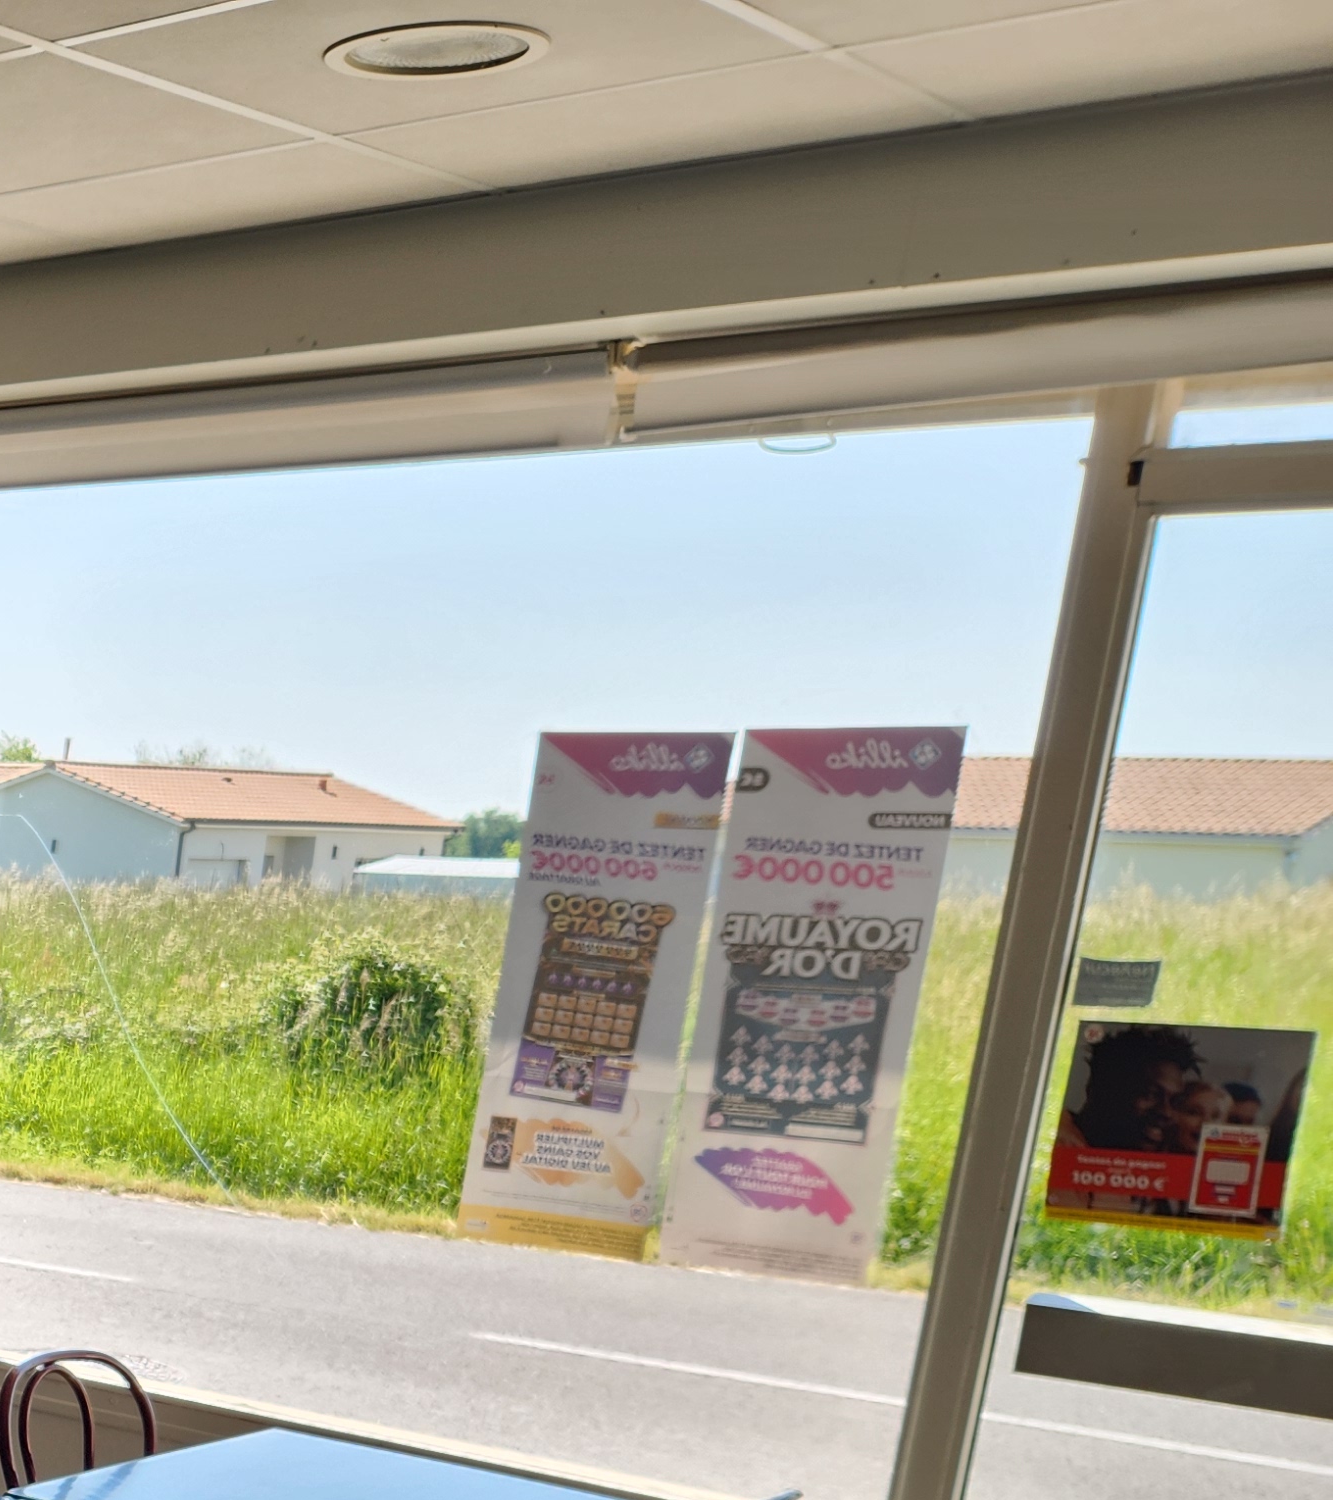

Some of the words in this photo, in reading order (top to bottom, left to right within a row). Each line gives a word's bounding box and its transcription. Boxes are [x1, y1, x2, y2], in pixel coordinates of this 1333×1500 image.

[1072, 1170, 1106, 1187] 100
[1109, 1173, 1150, 1190] 000
[1153, 1176, 1166, 1192] €
